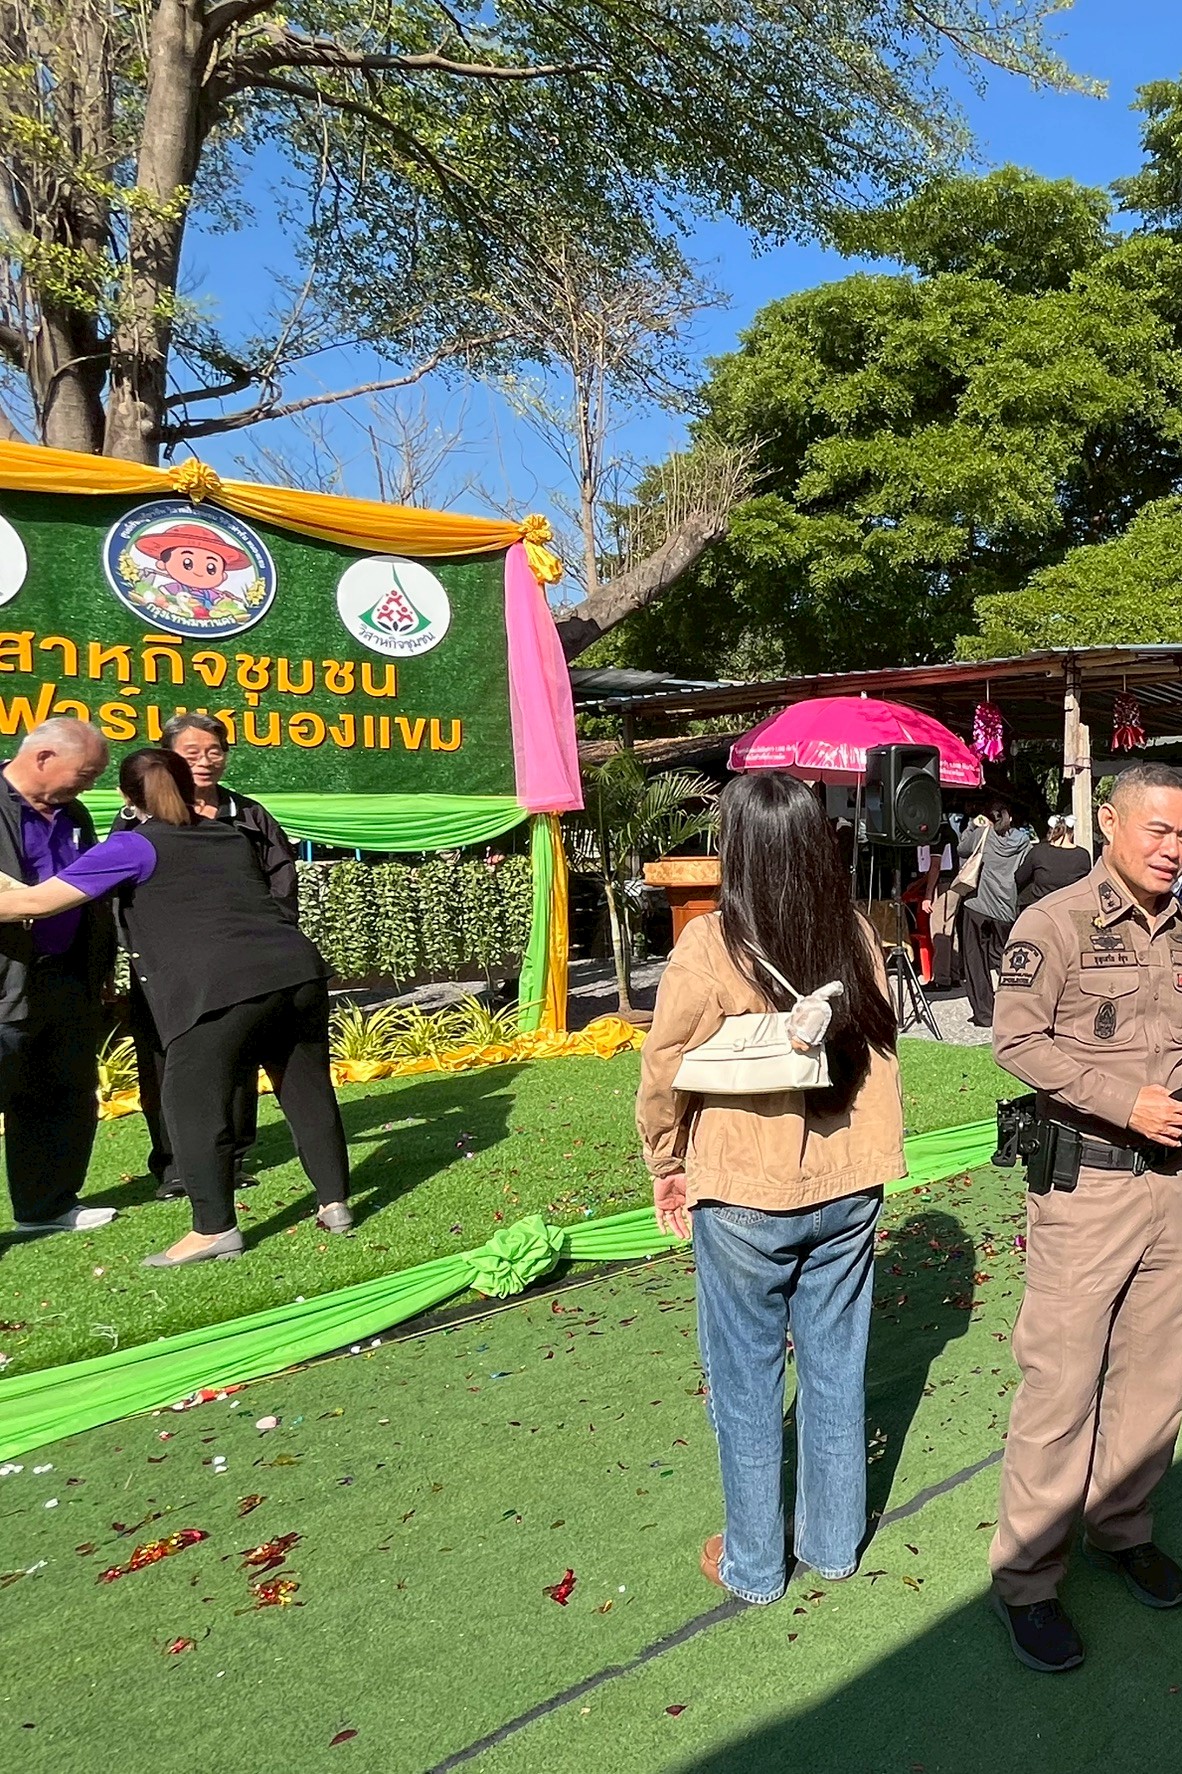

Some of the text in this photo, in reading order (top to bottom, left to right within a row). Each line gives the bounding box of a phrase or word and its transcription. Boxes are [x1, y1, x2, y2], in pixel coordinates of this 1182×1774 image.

[358, 623, 436, 652] วิสาหกิจชุมชน
